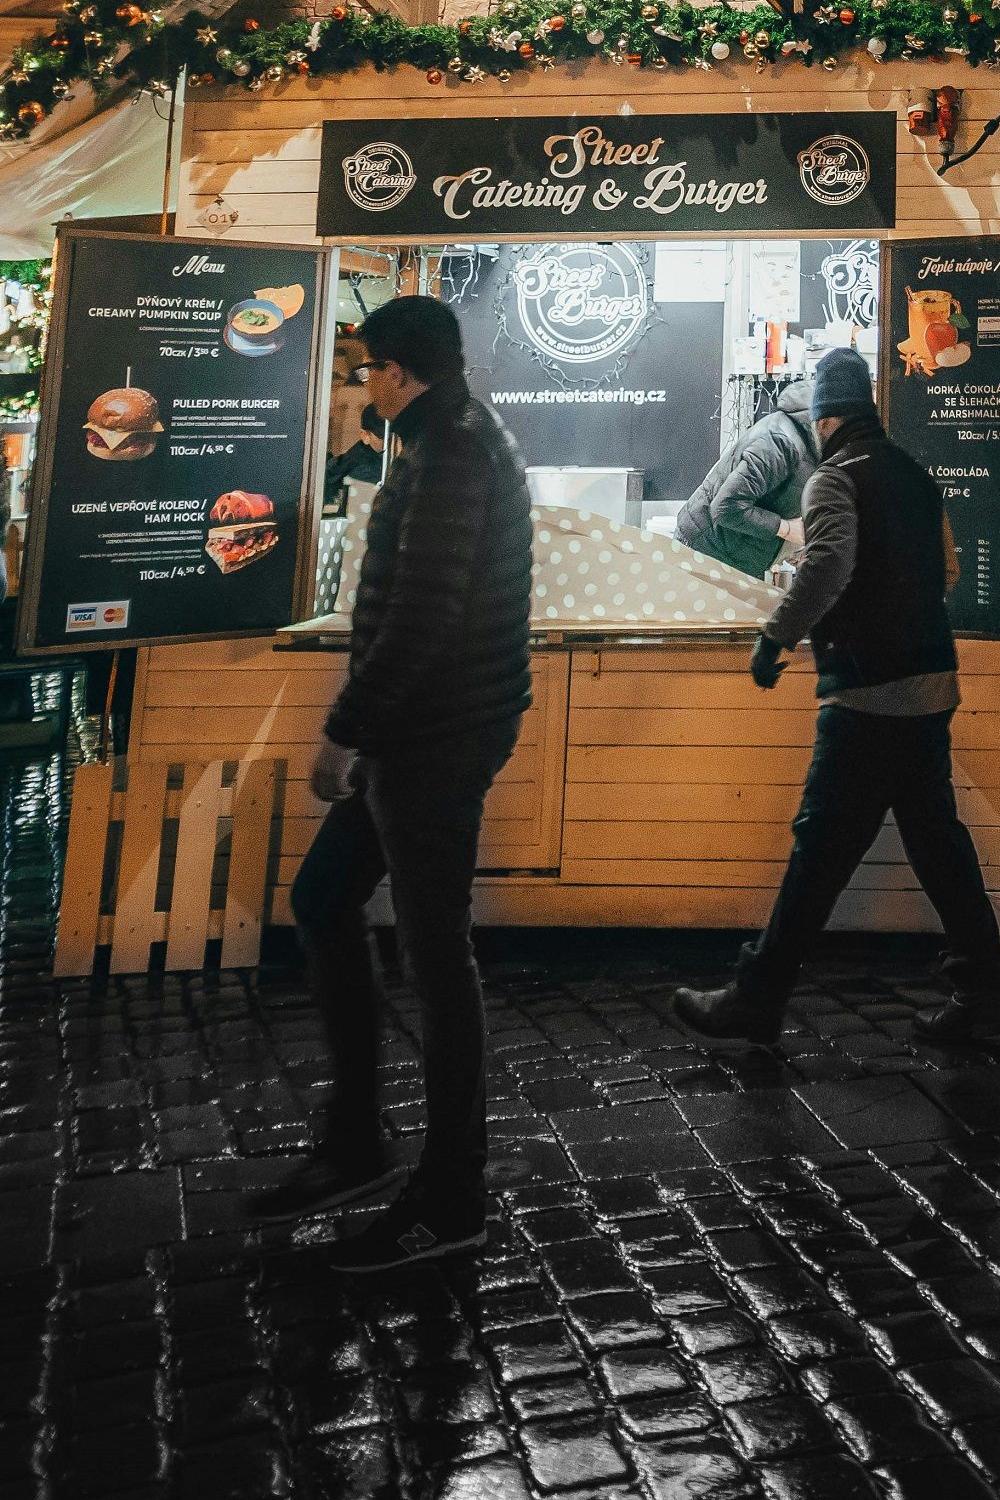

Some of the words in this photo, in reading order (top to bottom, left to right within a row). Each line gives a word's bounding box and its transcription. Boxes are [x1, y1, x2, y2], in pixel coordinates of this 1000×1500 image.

[822, 139, 848, 147] ORIGINAL
[543, 126, 665, 178] Street
[343, 156, 391, 176] Street
[799, 150, 847, 170] Street
[359, 171, 415, 191] Catering
[817, 165, 867, 185] Burger
[433, 167, 584, 220] Catering
[592, 177, 627, 210] &
[632, 161, 768, 213] Burger
[172, 255, 225, 277] Menu
[918, 256, 953, 280] Teplé
[955, 258, 993, 275] nápoje
[516, 259, 602, 297] Street
[137, 296, 183, 308] DÝŇOVÝ
[184, 297, 216, 309] KRÉM
[217, 299, 224, 310] /
[549, 287, 643, 323] Burger
[88, 308, 136, 319] CREAMY
[139, 309, 189, 320] PUMPKIN
[192, 310, 222, 321] SOUP
[210, 348, 219, 357] €
[927, 382, 961, 395] HORKÁ
[491, 386, 666, 406] www.streetcatering.cz
[944, 397, 957, 406] SE
[173, 399, 210, 409] PULLED
[212, 399, 239, 409] PORK
[240, 400, 280, 409] BURGER
[930, 409, 938, 419] A
[225, 444, 234, 454] €
[936, 465, 990, 477] ČOKOLÁDA
[963, 488, 970, 498] €
[71, 501, 107, 514] UZENÉ
[109, 499, 157, 513] VEPŘOVÉ
[158, 500, 199, 511] KOLENO
[200, 498, 207, 510] /
[144, 513, 171, 524] HAM
[173, 512, 205, 522] HOCK
[196, 565, 206, 575] €
[73, 613, 93, 622] VISA
